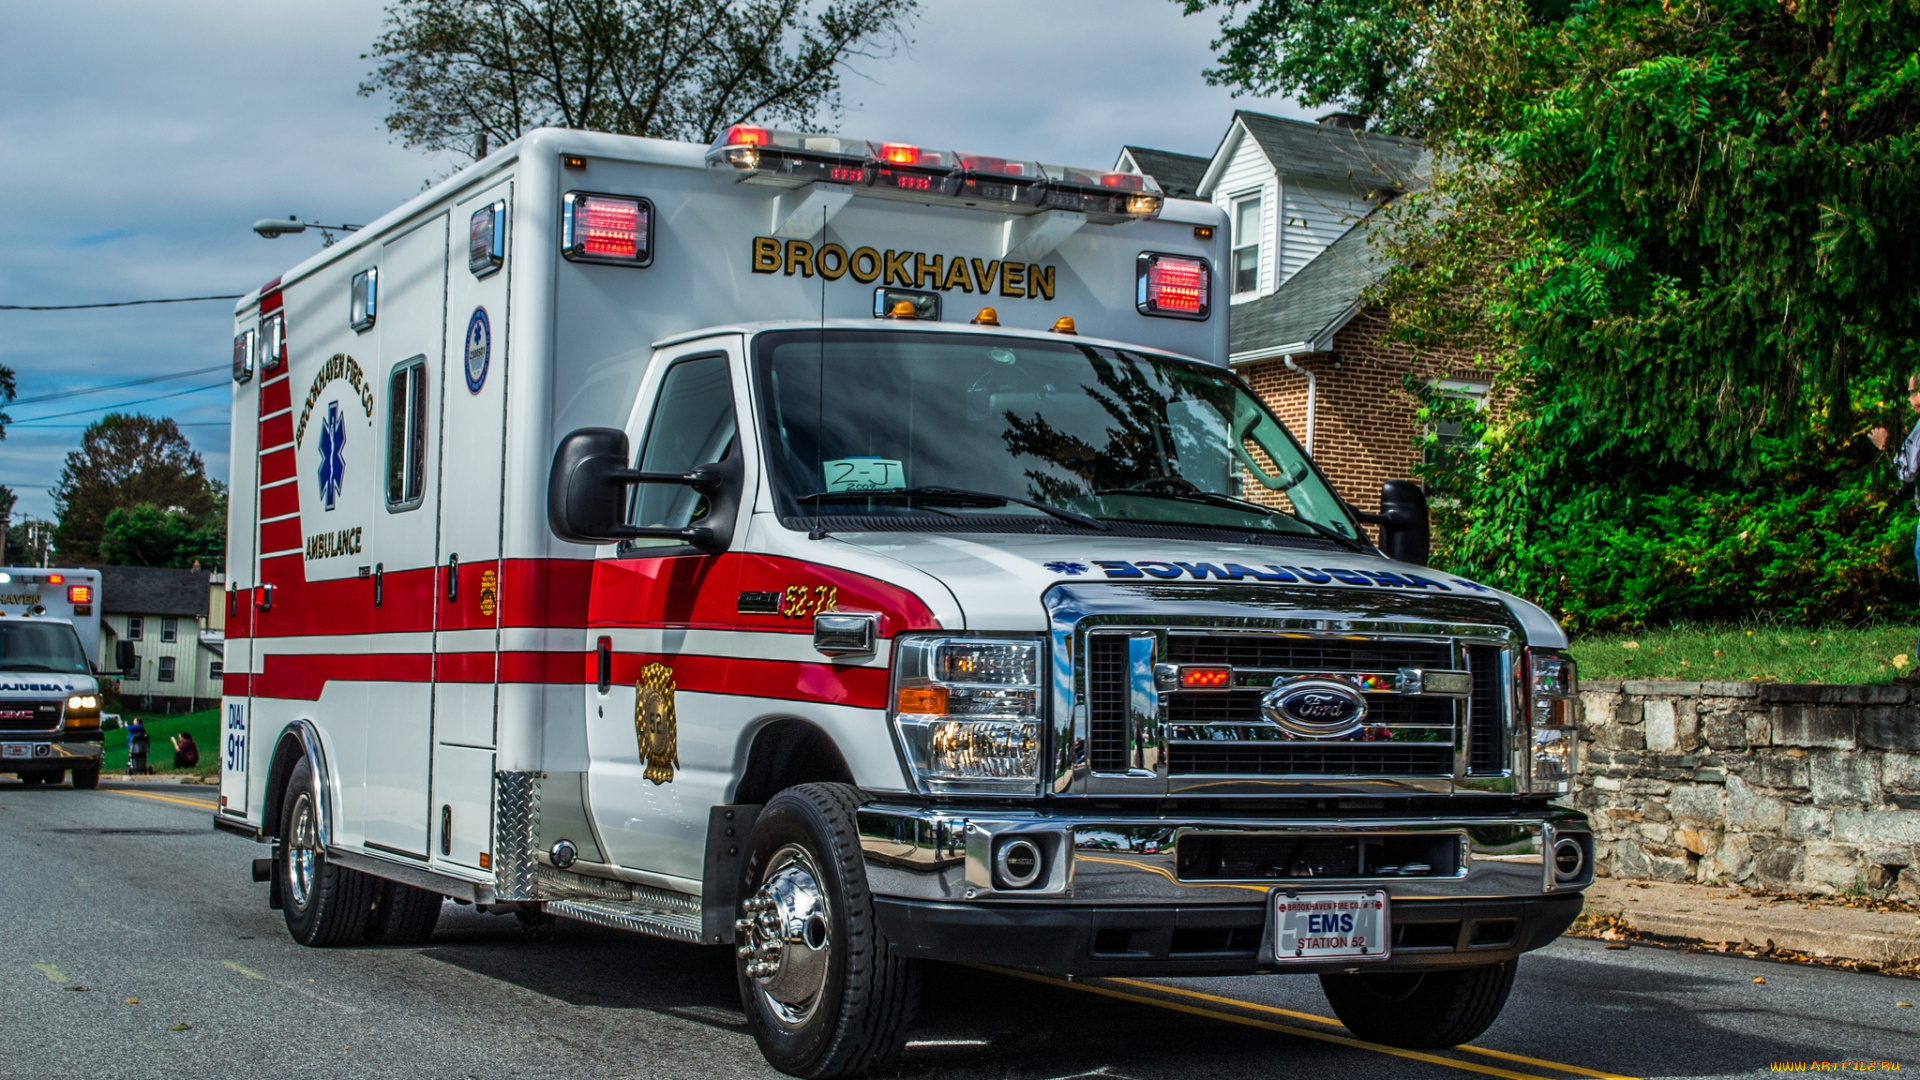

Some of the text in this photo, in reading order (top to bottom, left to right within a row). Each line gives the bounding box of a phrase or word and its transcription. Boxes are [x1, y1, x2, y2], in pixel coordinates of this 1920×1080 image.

[752, 236, 1056, 301] BROOKHAVEN
[296, 353, 373, 451] BROOKHAVEN FIRE CO.
[831, 463, 897, 485] 2-J
[305, 526, 362, 561] AMBULANCE
[782, 585, 840, 619] 52-7A
[0, 710, 34, 719] GMC
[228, 703, 246, 730] DIAL
[1299, 694, 1344, 716] Ford
[649, 712, 662, 735] 52
[227, 733, 246, 772] 911
[1287, 902, 1332, 912] BROOKHAVEN
[1333, 902, 1348, 910] FIRE
[1350, 902, 1361, 910] CO.
[1308, 914, 1353, 933] EMS
[1297, 936, 1365, 949] STATION 52
